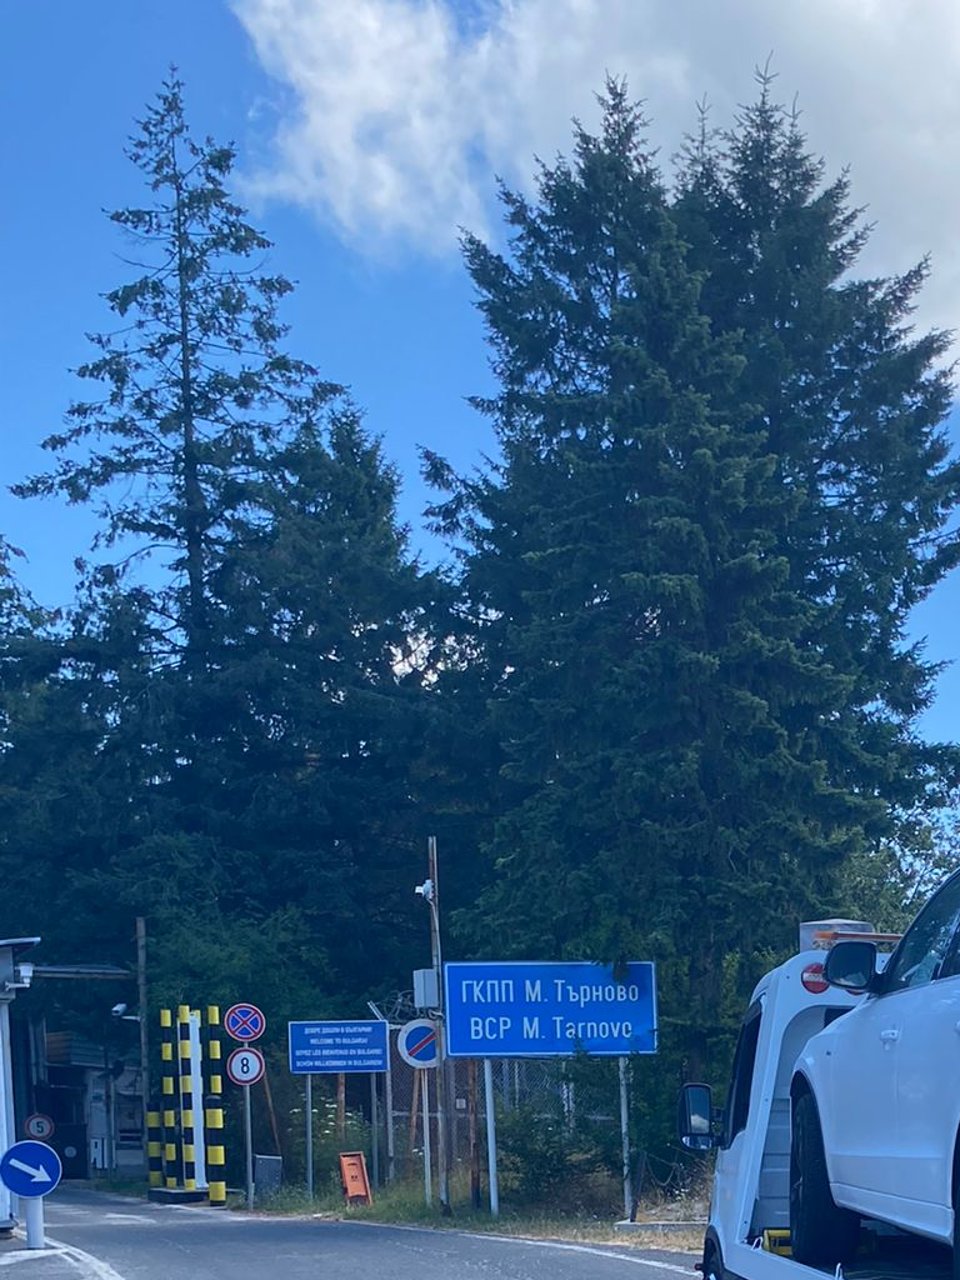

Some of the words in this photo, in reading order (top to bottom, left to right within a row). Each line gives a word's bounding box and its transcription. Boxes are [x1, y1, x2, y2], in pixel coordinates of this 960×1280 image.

[462, 980, 514, 1003] ГКПП
[554, 979, 639, 1008] Търново
[552, 1016, 632, 1039] Tarnovo
[240, 1057, 250, 1075] 8
[36, 1121, 44, 1132] 5
